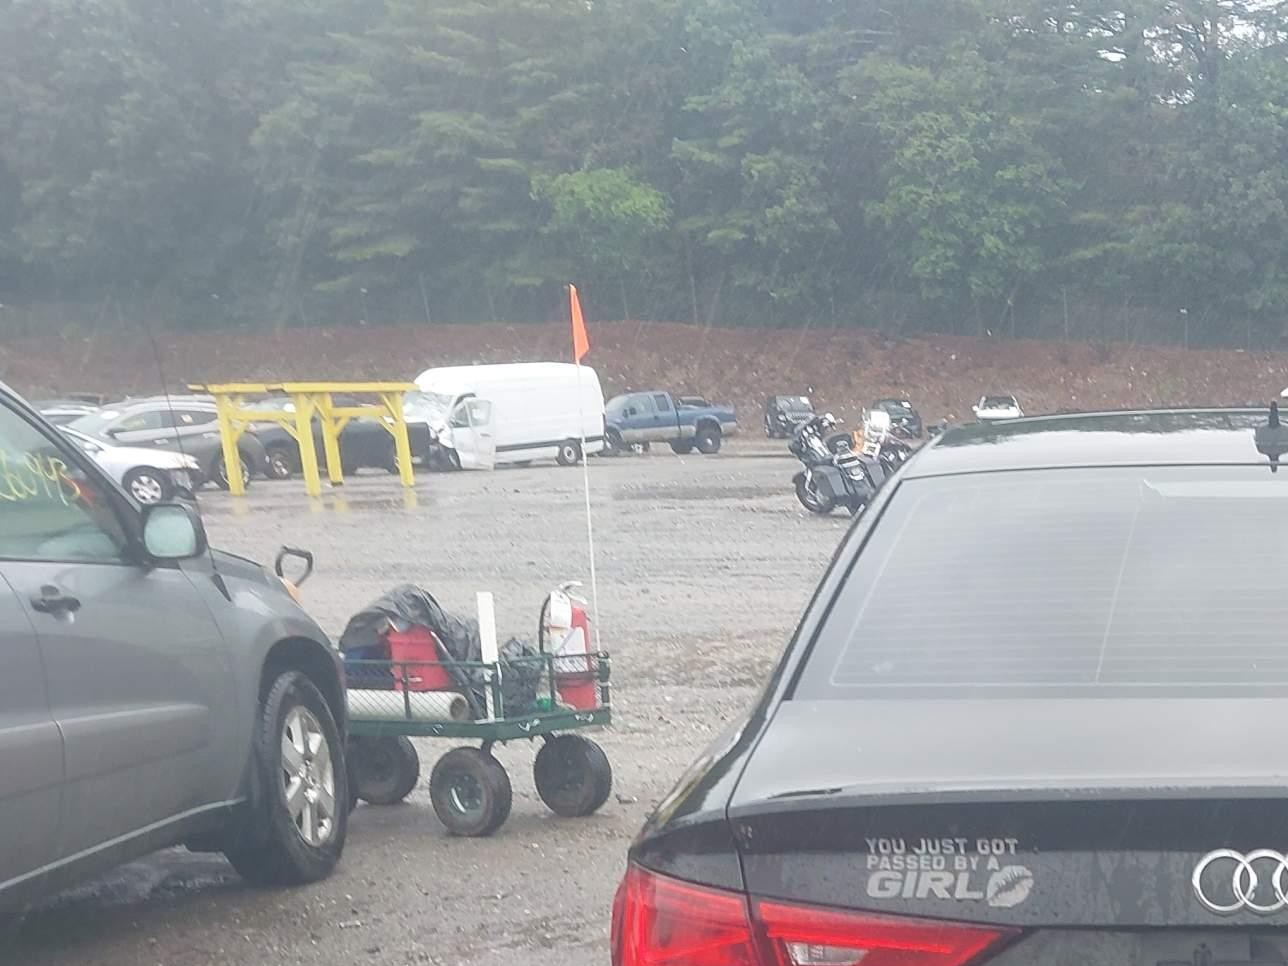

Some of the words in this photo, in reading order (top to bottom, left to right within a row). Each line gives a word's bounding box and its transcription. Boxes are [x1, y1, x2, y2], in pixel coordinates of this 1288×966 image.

[865, 838, 906, 854] YOU
[912, 838, 968, 854] JUST
[977, 838, 1018, 854] GOT
[867, 855, 945, 870] PASSED
[955, 855, 979, 870] BY
[987, 856, 999, 870] A
[866, 871, 984, 899] GIRL
